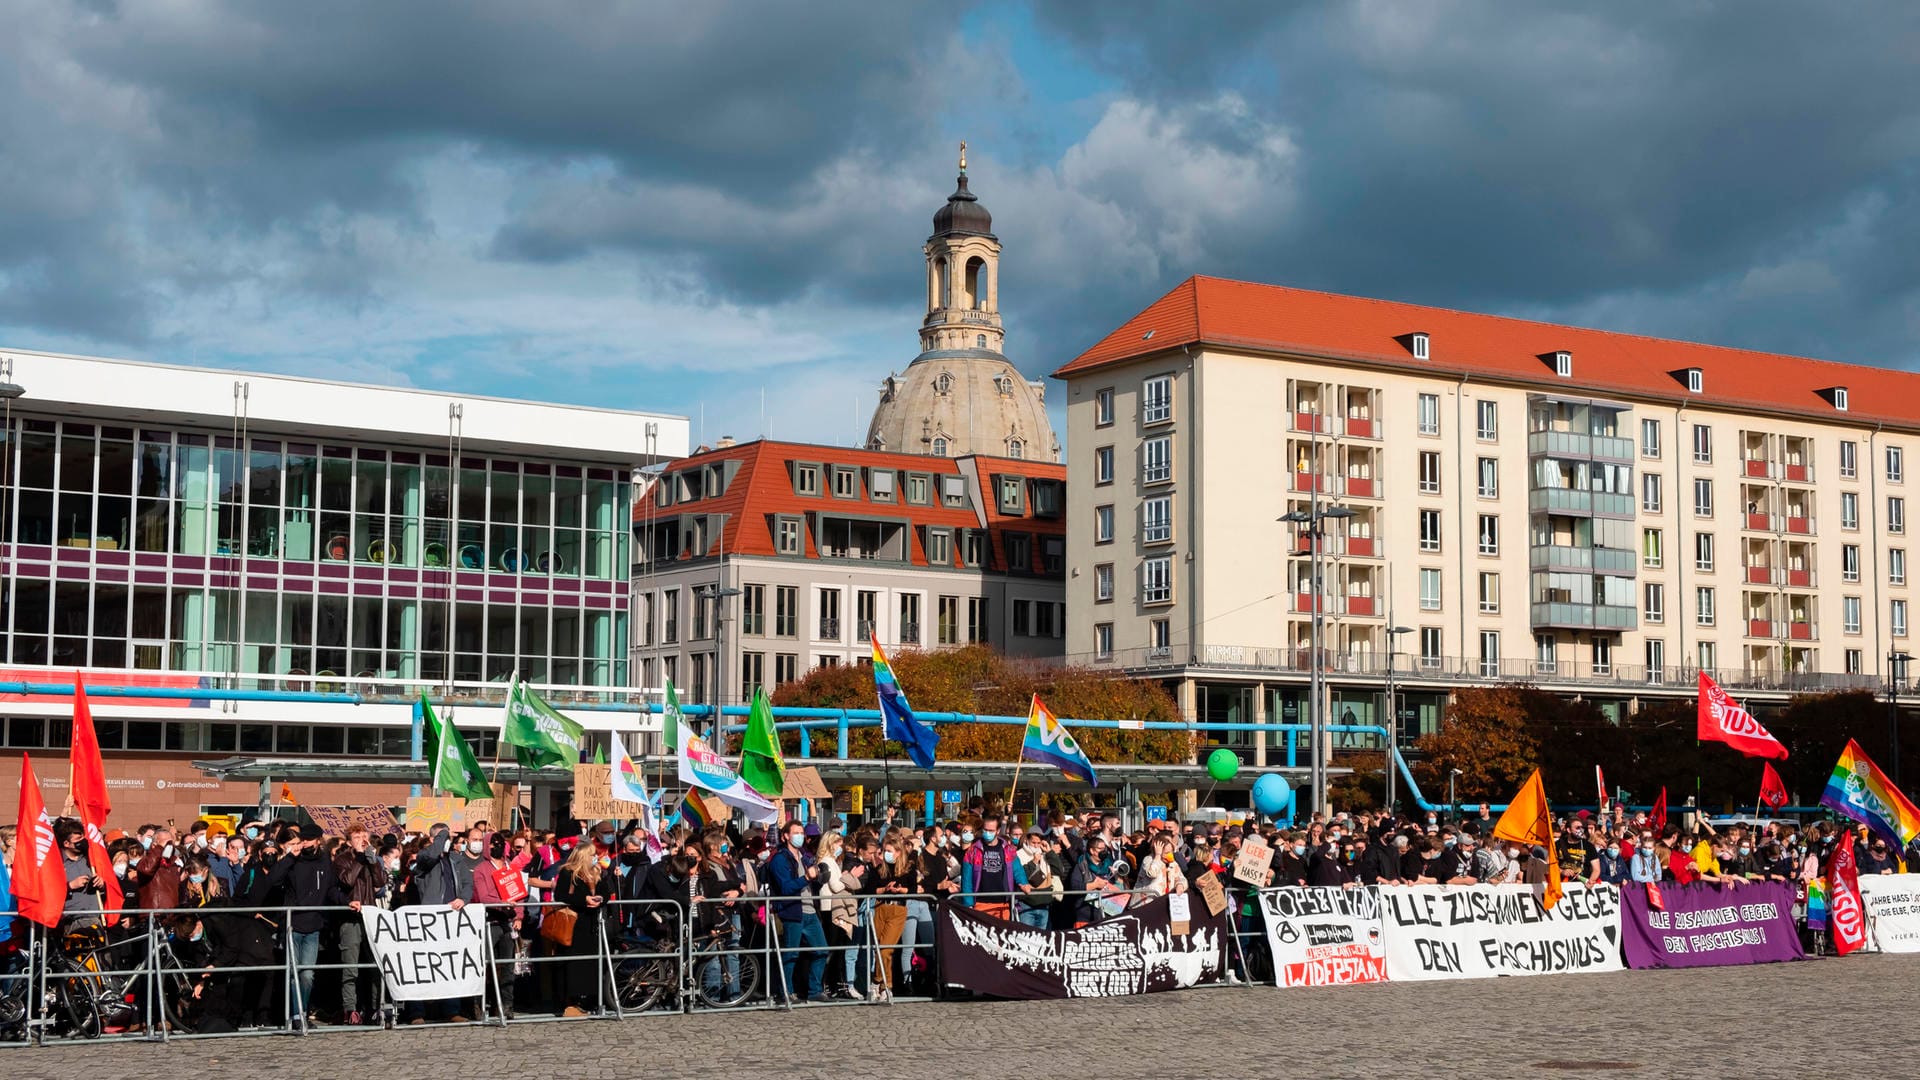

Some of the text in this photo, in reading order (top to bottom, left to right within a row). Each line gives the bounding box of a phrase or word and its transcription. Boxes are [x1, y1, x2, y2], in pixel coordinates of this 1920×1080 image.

[695, 762, 736, 780] ALTERNATIVE
[583, 800, 641, 815] PARLAMENTEN
[1741, 903, 1778, 922] GEGEN
[374, 907, 482, 944] ALERTA,
[1414, 938, 1464, 974] DEN
[1479, 935, 1606, 972] FASCHISMUS
[1663, 935, 1689, 953] DEN
[381, 947, 484, 987] ALERTA!
[1070, 970, 1141, 997] HISTORY
